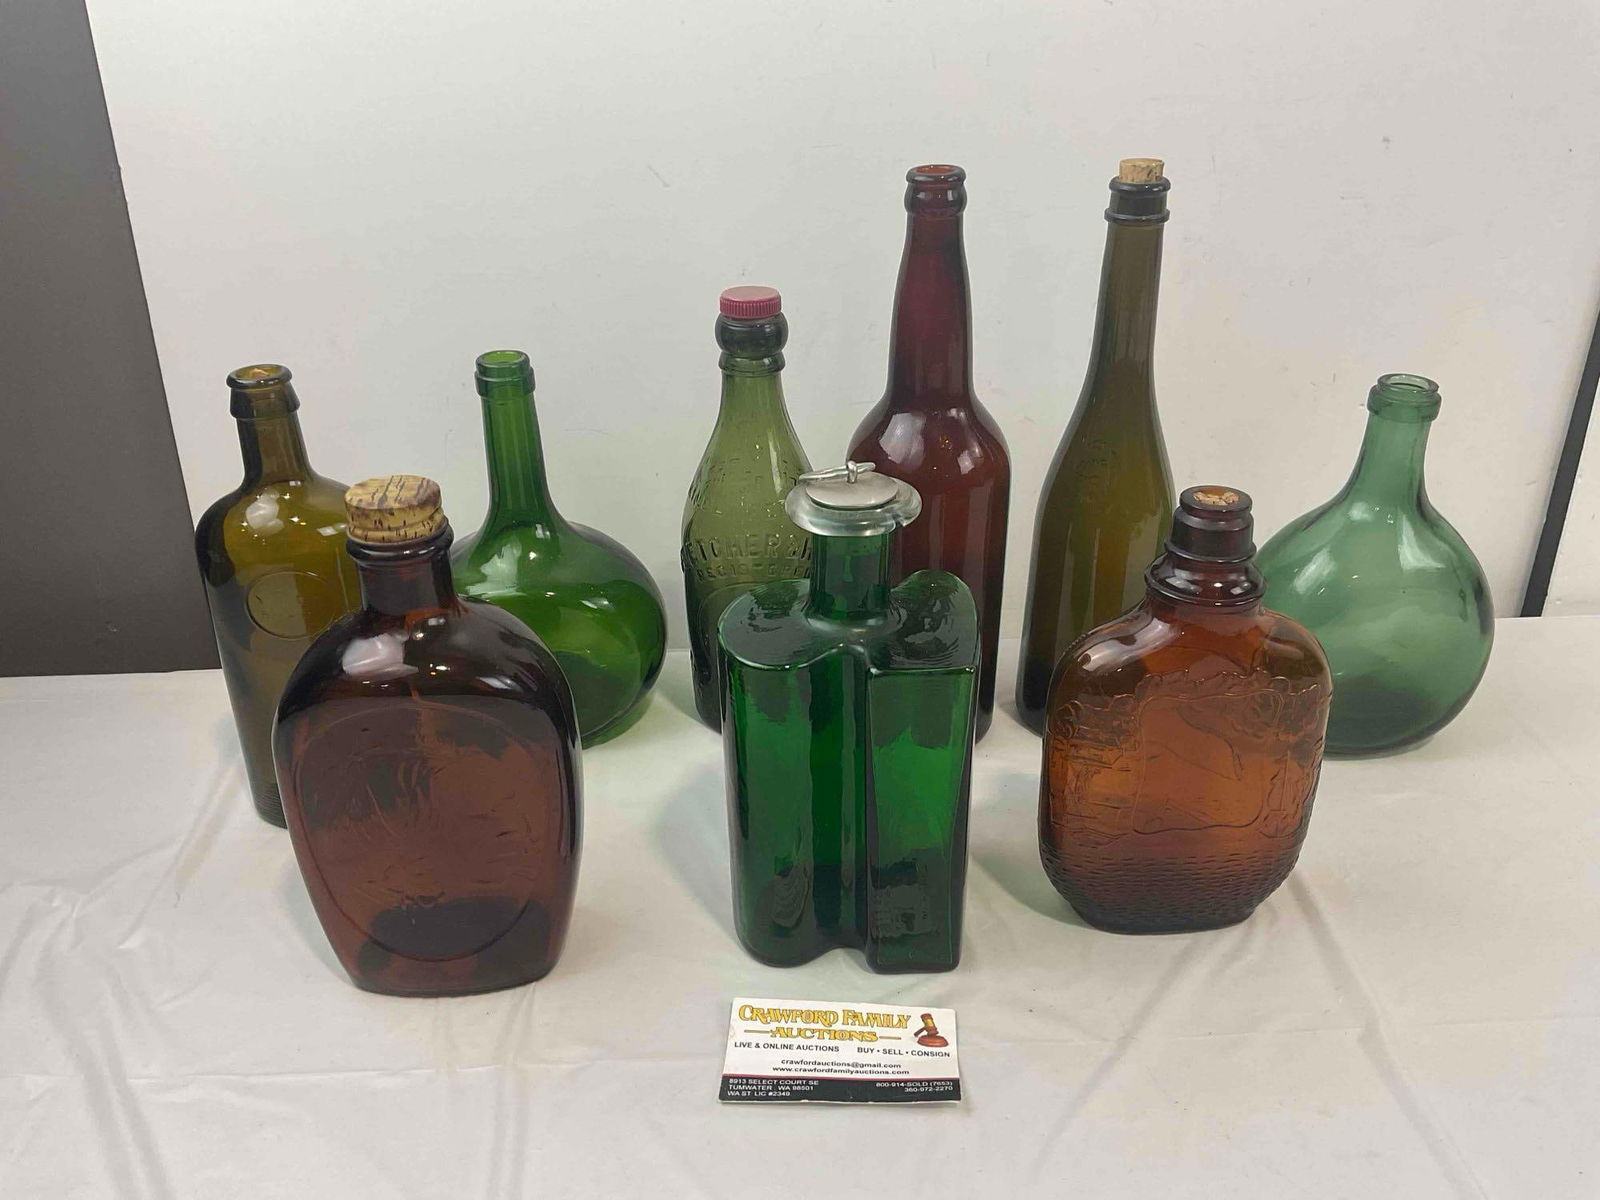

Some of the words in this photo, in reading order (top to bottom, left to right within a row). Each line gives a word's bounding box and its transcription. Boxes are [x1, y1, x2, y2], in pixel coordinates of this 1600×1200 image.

[738, 1004, 839, 1027] CRAWFORD
[842, 1009, 912, 1029] FAMILY
[770, 1026, 879, 1042] AUCTIONS
[734, 1041, 753, 1049] LIVE
[762, 1042, 794, 1050] ONLINE
[796, 1044, 840, 1052] AUCTIONS
[882, 1048, 904, 1056] SELL
[911, 1049, 950, 1057] CONSIGN
[781, 1058, 902, 1069] crawfordauctions@gmail.com
[772, 1066, 910, 1075] www.crawfordfamilyauctions.com
